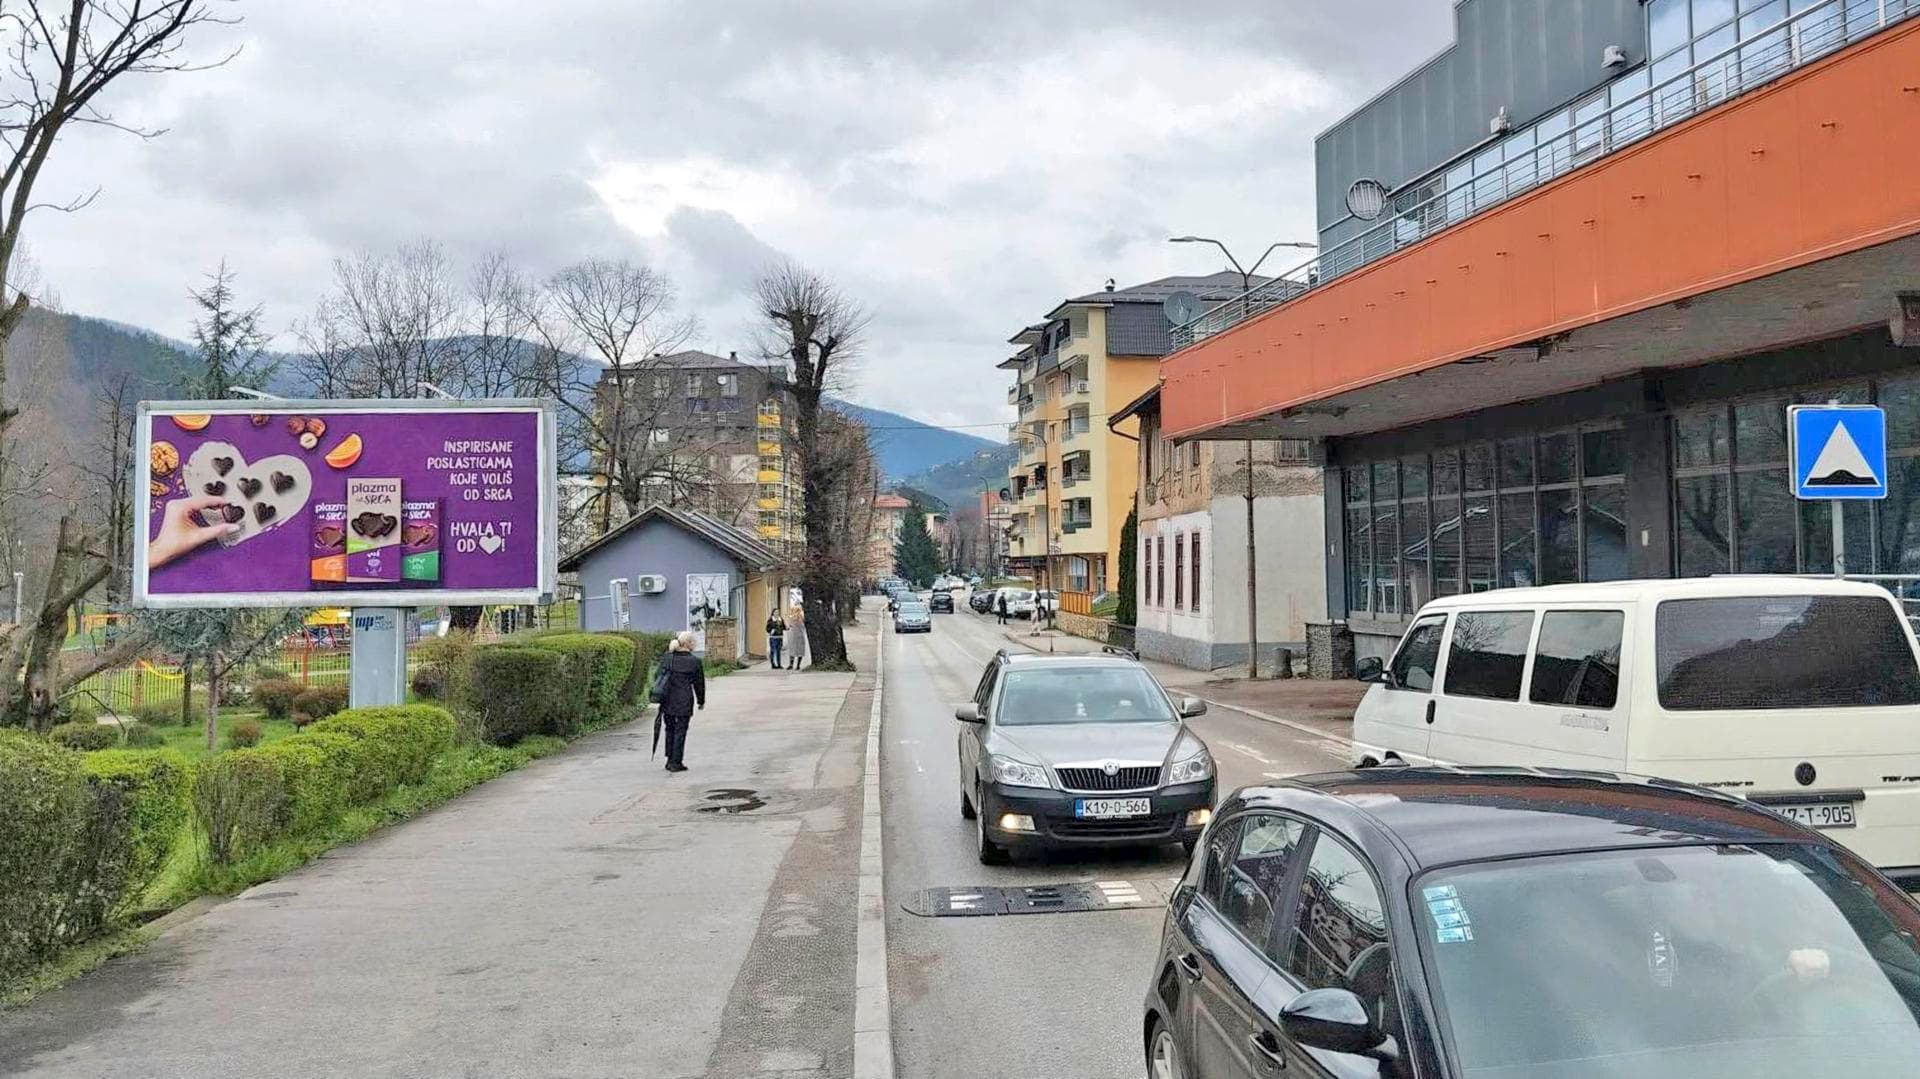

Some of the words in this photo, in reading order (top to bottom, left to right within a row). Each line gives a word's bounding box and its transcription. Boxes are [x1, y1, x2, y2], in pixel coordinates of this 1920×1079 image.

[443, 440, 513, 453] INSPIRISANE
[427, 456, 513, 470] POSLASTICAMA
[450, 472, 478, 485] KOJE
[482, 470, 513, 485] VOLIŠ
[352, 483, 397, 496] plazma
[463, 488, 480, 501] OD
[484, 488, 513, 501] SRCA
[315, 502, 346, 514] plazm
[450, 522, 494, 536] HVALA
[500, 521, 512, 536] TI
[457, 538, 477, 552] OD
